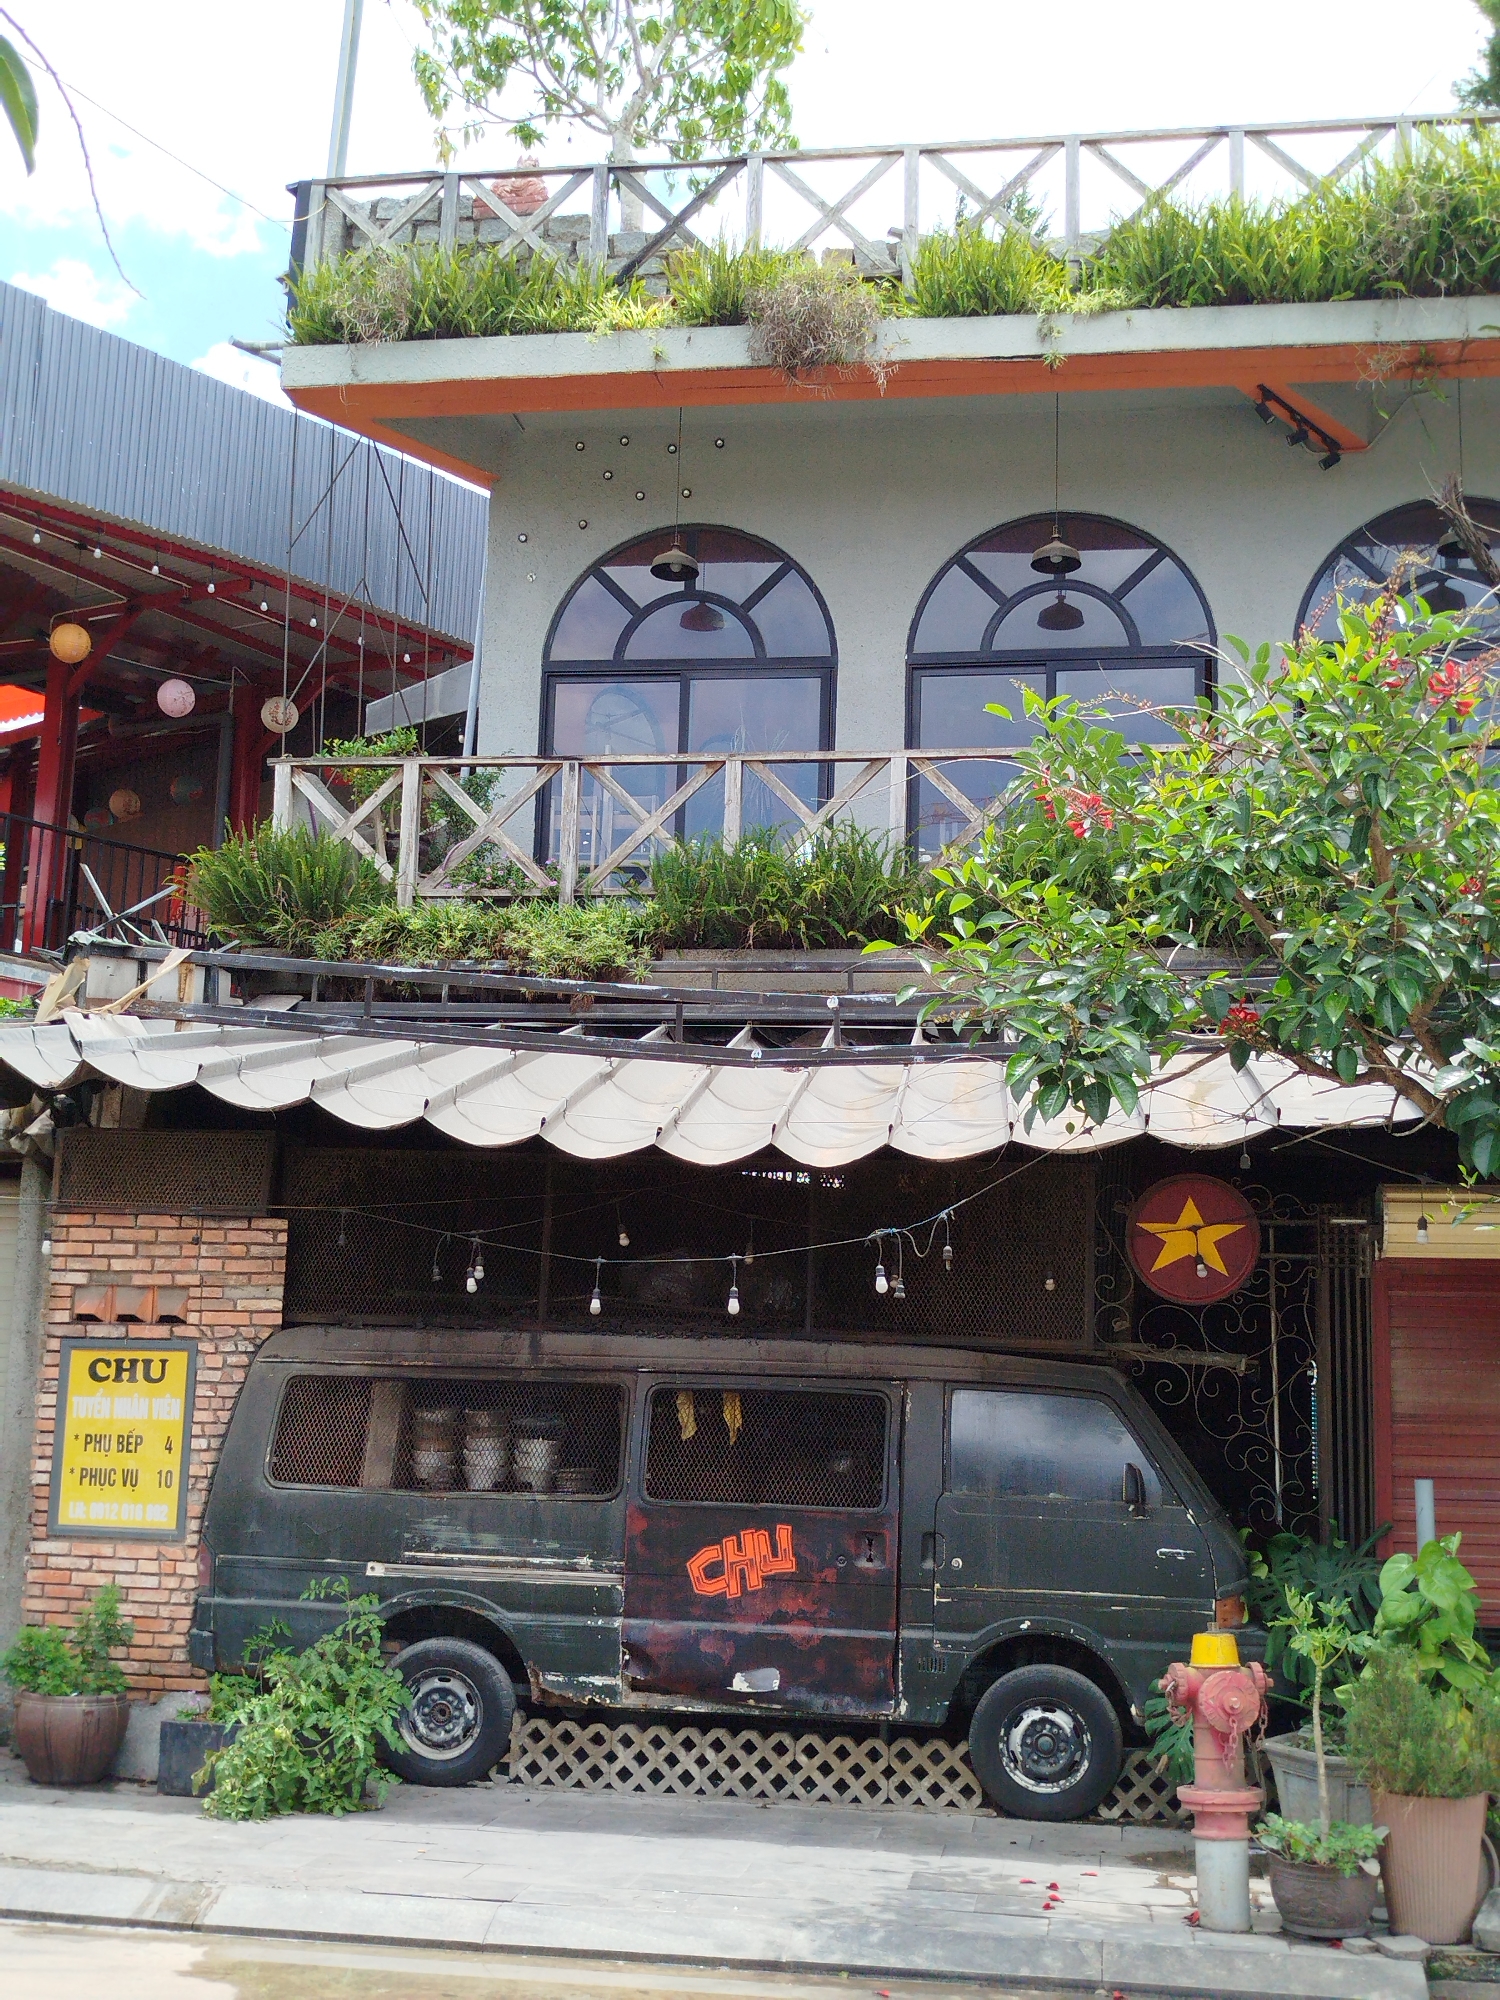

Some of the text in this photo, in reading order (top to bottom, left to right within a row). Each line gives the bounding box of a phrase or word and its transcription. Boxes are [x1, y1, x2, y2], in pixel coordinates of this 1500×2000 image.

[88, 1357, 170, 1384] CHU
[113, 1393, 149, 1419] NHÂN
[152, 1393, 181, 1420] VIÊN
[83, 1428, 173, 1457] PHỤ BẾP 4
[79, 1467, 173, 1492] PHỤC VỤ 10
[686, 1524, 796, 1599] CHU
